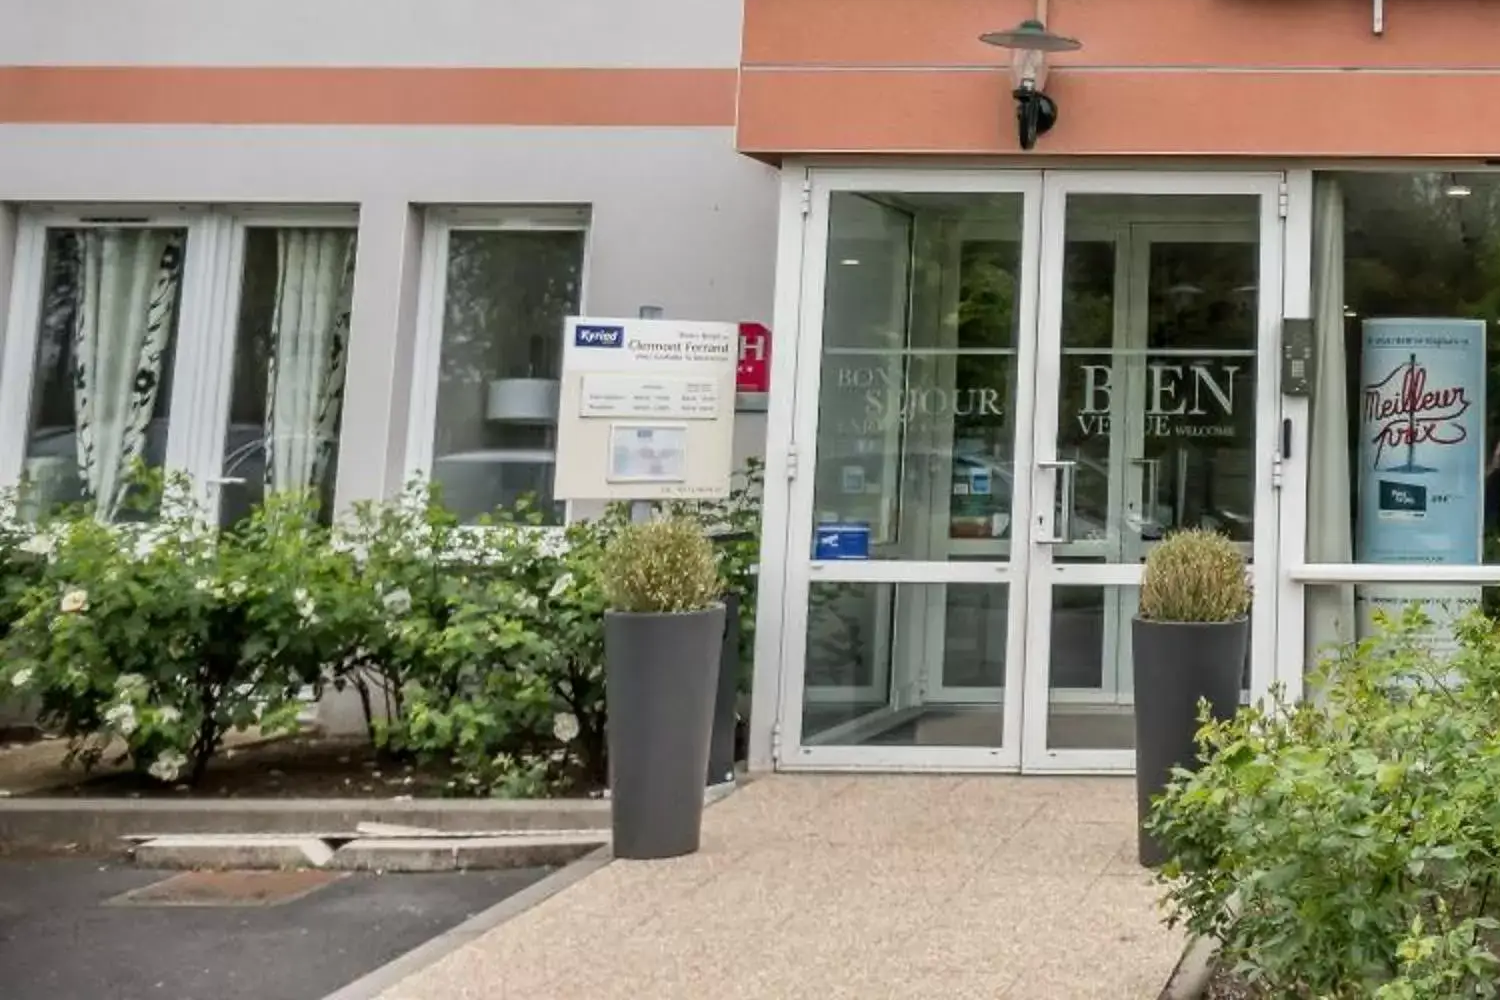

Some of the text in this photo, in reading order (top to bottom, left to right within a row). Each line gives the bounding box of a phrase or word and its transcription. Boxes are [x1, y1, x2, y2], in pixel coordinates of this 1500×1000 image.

[628, 339, 729, 354] Clermont Ferrand
[739, 335, 766, 362] H
[863, 387, 1004, 420] SJOUR
[1077, 364, 1241, 416] BEN
[1363, 366, 1470, 423] Meilleur
[1076, 414, 1238, 438] VEUE WELCOME
[1373, 419, 1467, 470] prix
